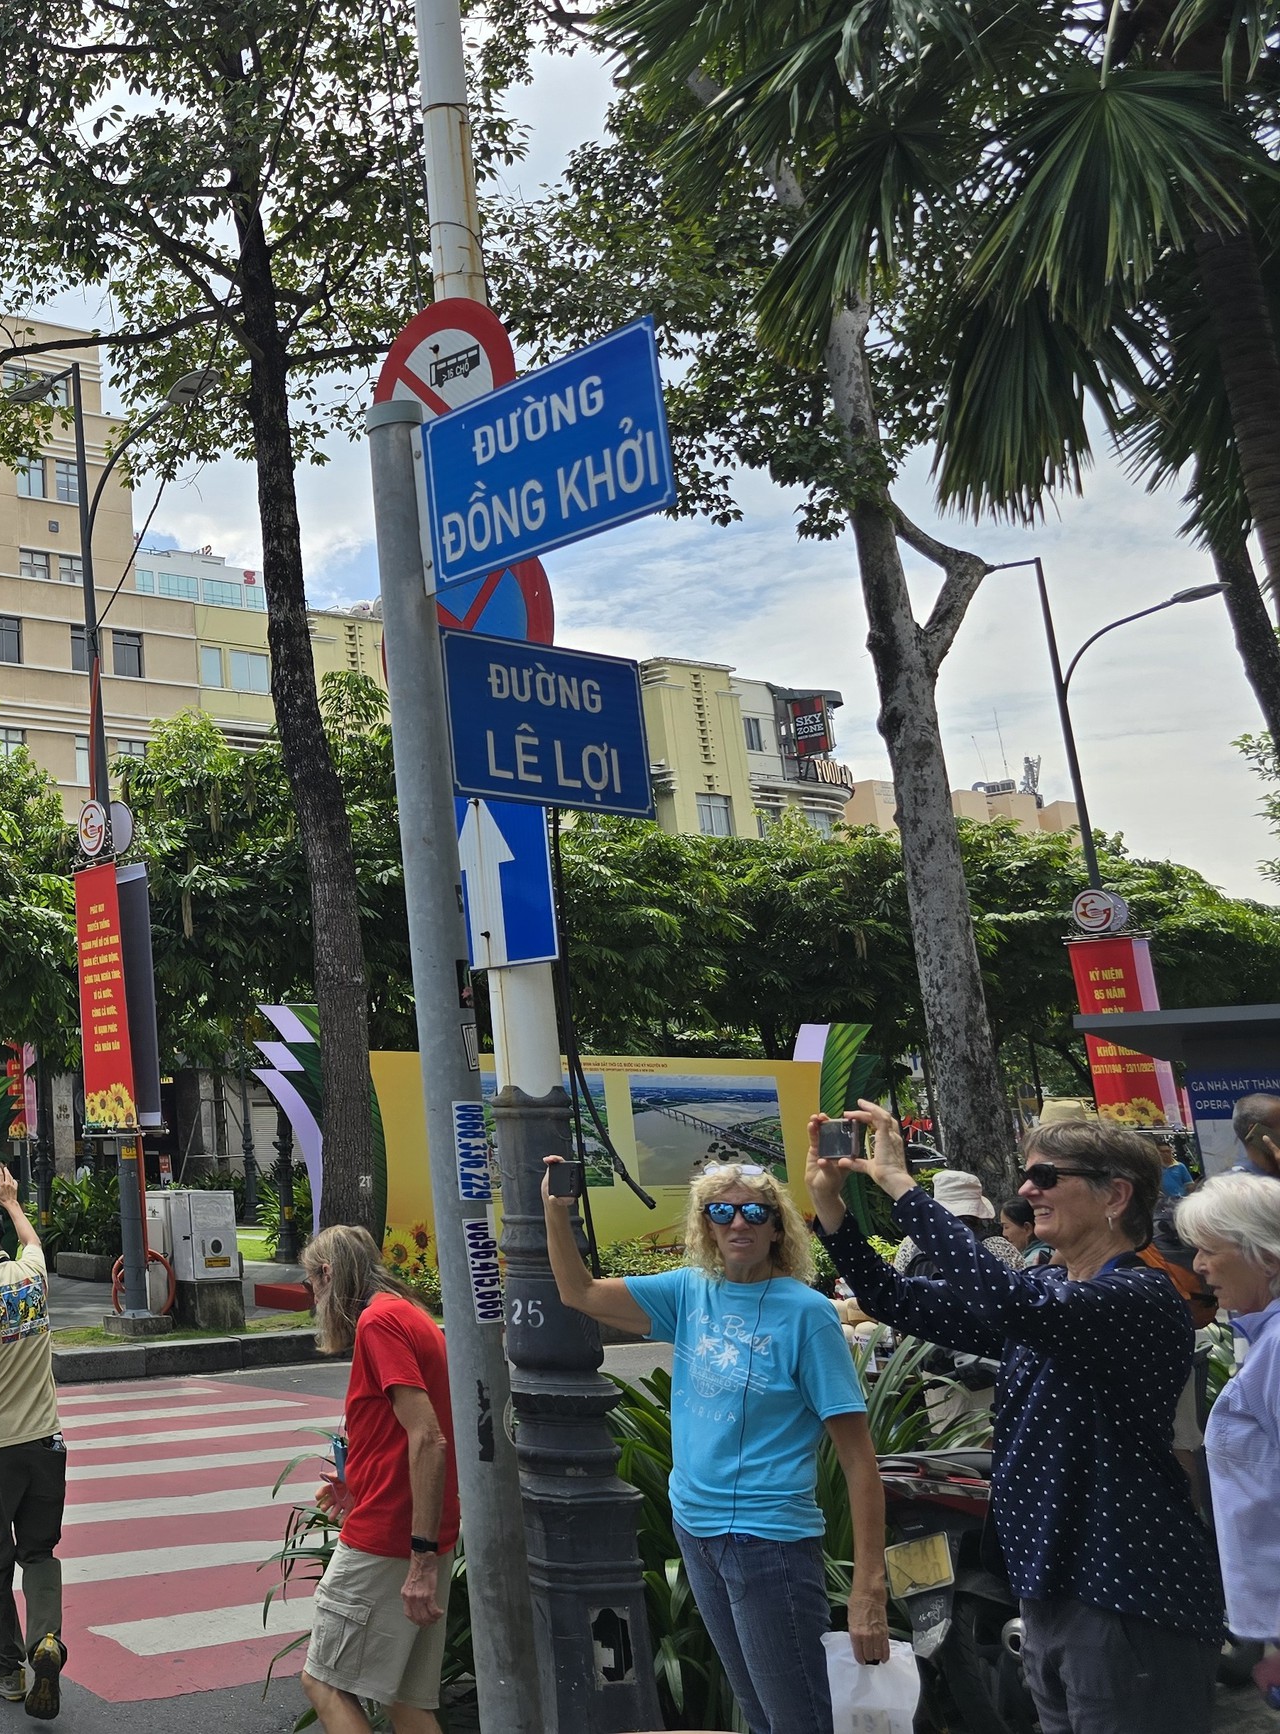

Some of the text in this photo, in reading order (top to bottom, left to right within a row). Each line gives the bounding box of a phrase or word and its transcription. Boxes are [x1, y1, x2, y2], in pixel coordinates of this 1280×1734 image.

[472, 375, 604, 466] ĐƯỜNG
[442, 416, 659, 563] ĐỒNG KHỞI
[487, 662, 602, 714] ĐƯỜNG
[795, 712, 822, 727] SKY
[796, 723, 824, 736] ZONE
[486, 722, 622, 801] LÊ LỢI
[1102, 968, 1124, 982] NIỆM
[1093, 987, 1126, 1000] 85 NĂM
[1191, 1076, 1280, 1092] GA NHÀ HÁT THÀN
[1195, 1100, 1230, 1110] OPERA
[455, 1104, 492, 1199] 0868.336.229
[511, 1298, 545, 1329] 25
[722, 1314, 772, 1356] Beach
